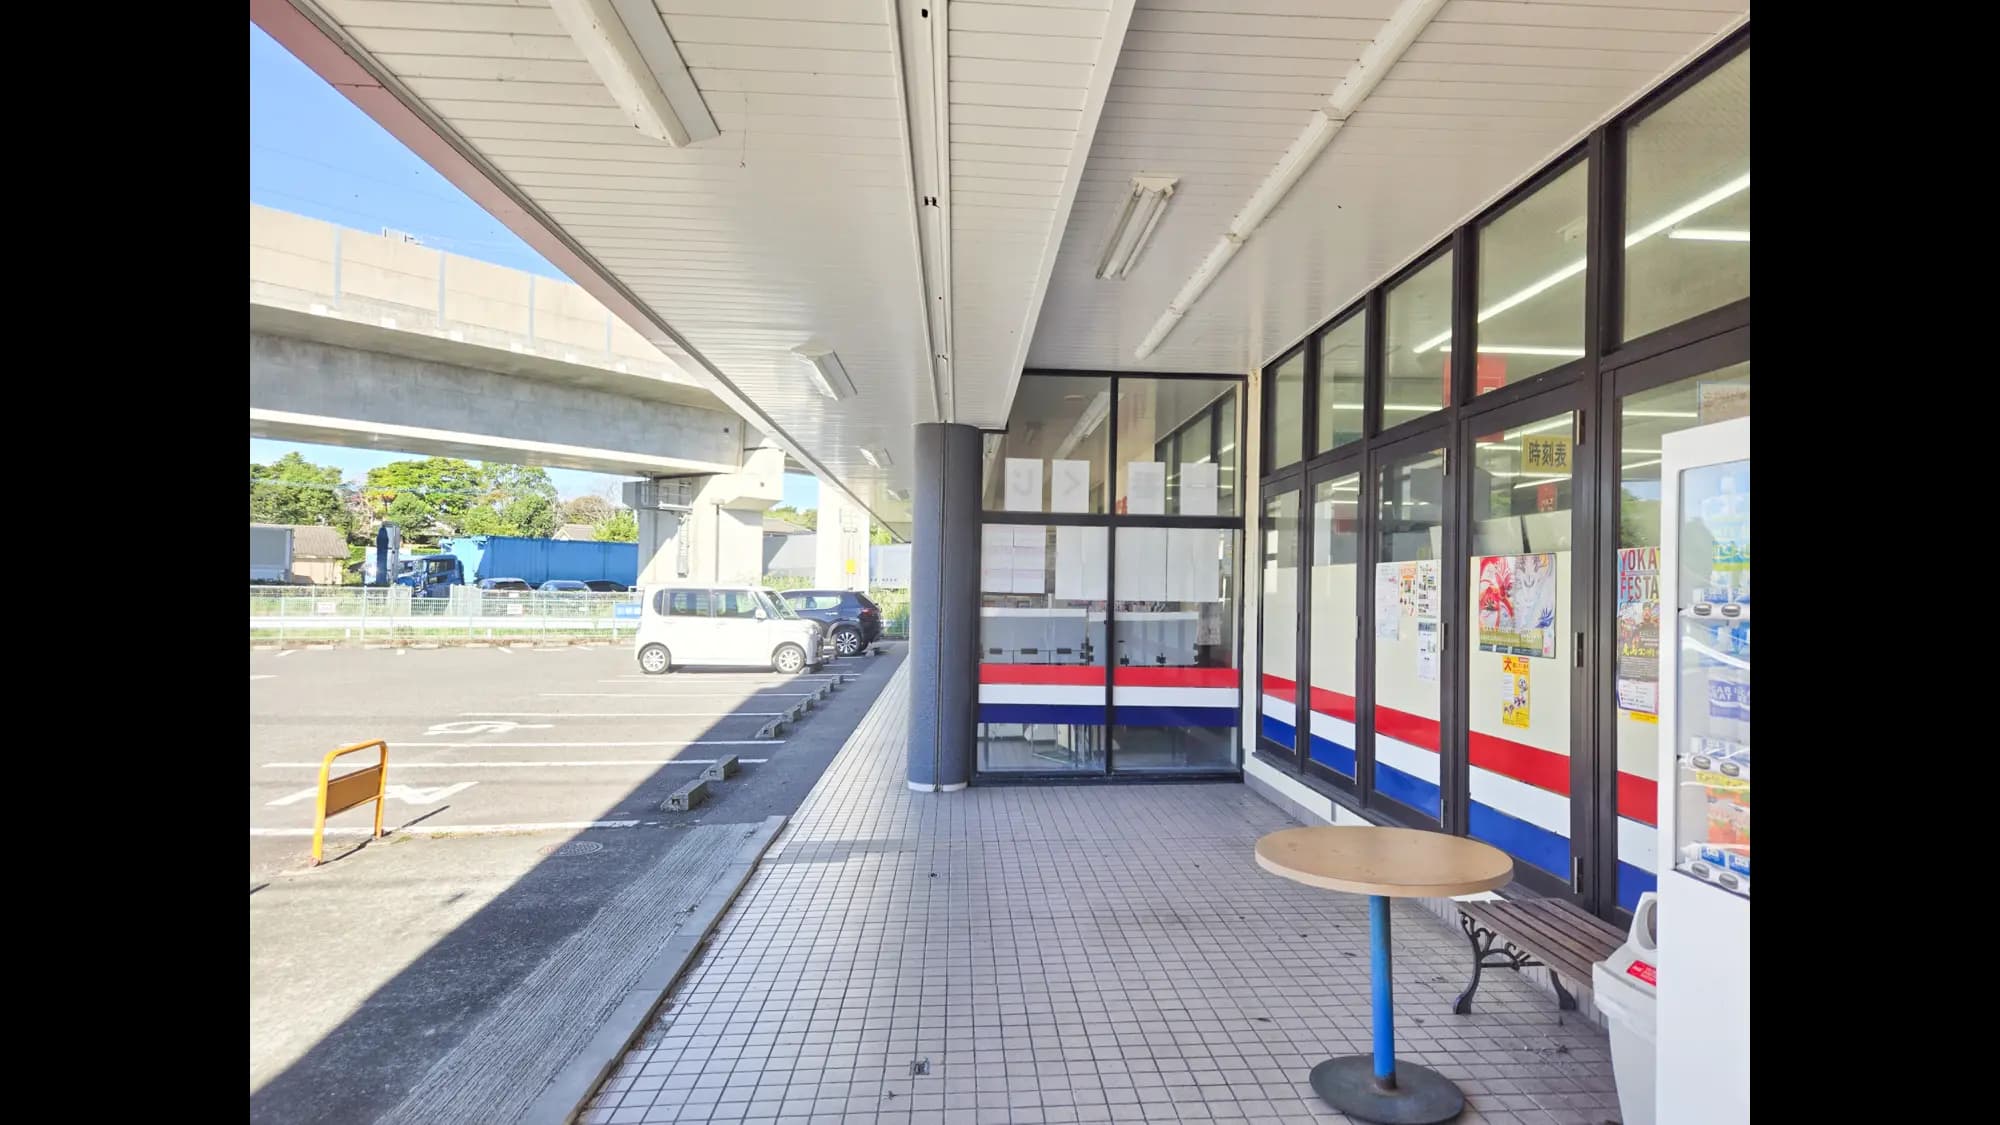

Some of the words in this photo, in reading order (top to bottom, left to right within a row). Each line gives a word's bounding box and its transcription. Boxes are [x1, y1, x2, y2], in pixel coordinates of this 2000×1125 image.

[1528, 440, 1568, 466] 時刻表
[1620, 576, 1660, 600] FESTA
